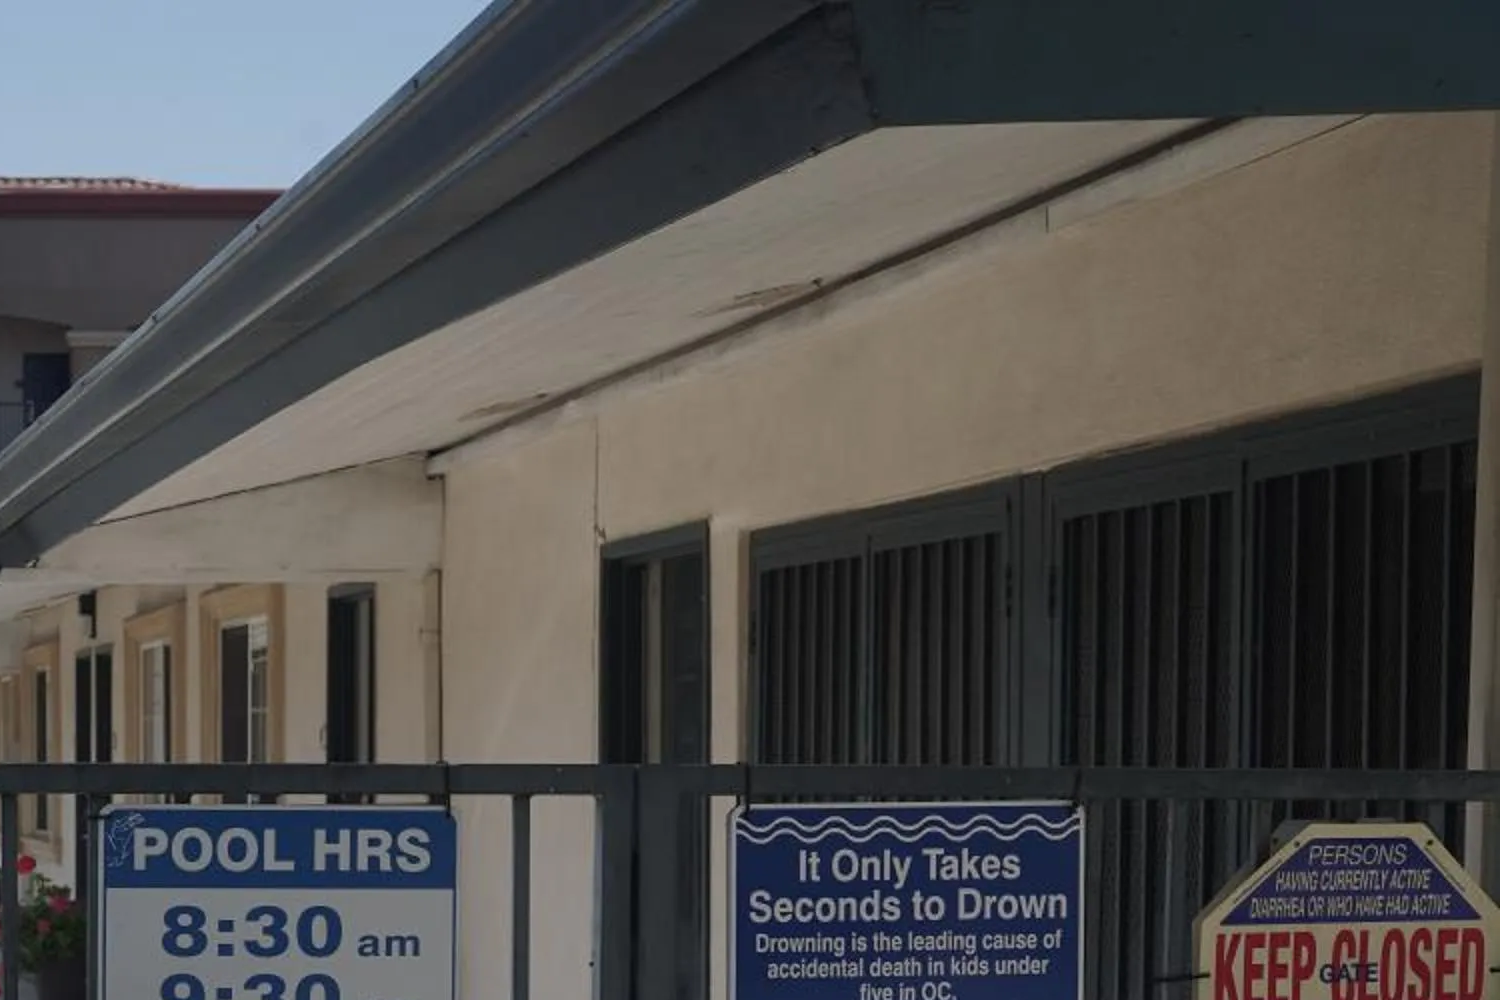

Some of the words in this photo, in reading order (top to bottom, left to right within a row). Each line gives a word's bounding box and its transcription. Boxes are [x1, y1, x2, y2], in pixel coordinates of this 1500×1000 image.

[133, 827, 295, 872] POOL
[314, 827, 431, 872] HRS
[1308, 843, 1408, 866] PERSONS
[799, 848, 821, 882] It
[831, 848, 912, 890] Only
[921, 847, 1021, 881] Takes
[1275, 870, 1318, 892] HAVING
[1320, 868, 1388, 891] CURRENTLY
[1389, 867, 1432, 890] ACTIVE
[749, 889, 901, 923] Seconds
[911, 889, 945, 921] to
[958, 887, 1067, 920] Drown
[1251, 896, 1305, 918] DIARRHEA
[1308, 896, 1325, 917] OR
[1326, 895, 1355, 917] WHO
[1355, 895, 1384, 916] HAVE
[1386, 894, 1409, 916] HAD
[1411, 893, 1451, 915] ACTIVE
[161, 905, 342, 958] 8:30
[357, 934, 421, 957] am
[755, 932, 845, 957] Drowning
[851, 931, 867, 952] is
[873, 931, 902, 952] the
[908, 930, 976, 955] leading
[982, 932, 1037, 950] cause
[1043, 929, 1063, 949] of
[767, 957, 864, 979] accidental
[869, 956, 921, 977] death
[927, 957, 944, 976] in
[951, 955, 989, 975] kids
[995, 955, 1050, 975] under
[1319, 963, 1379, 984] GATE
